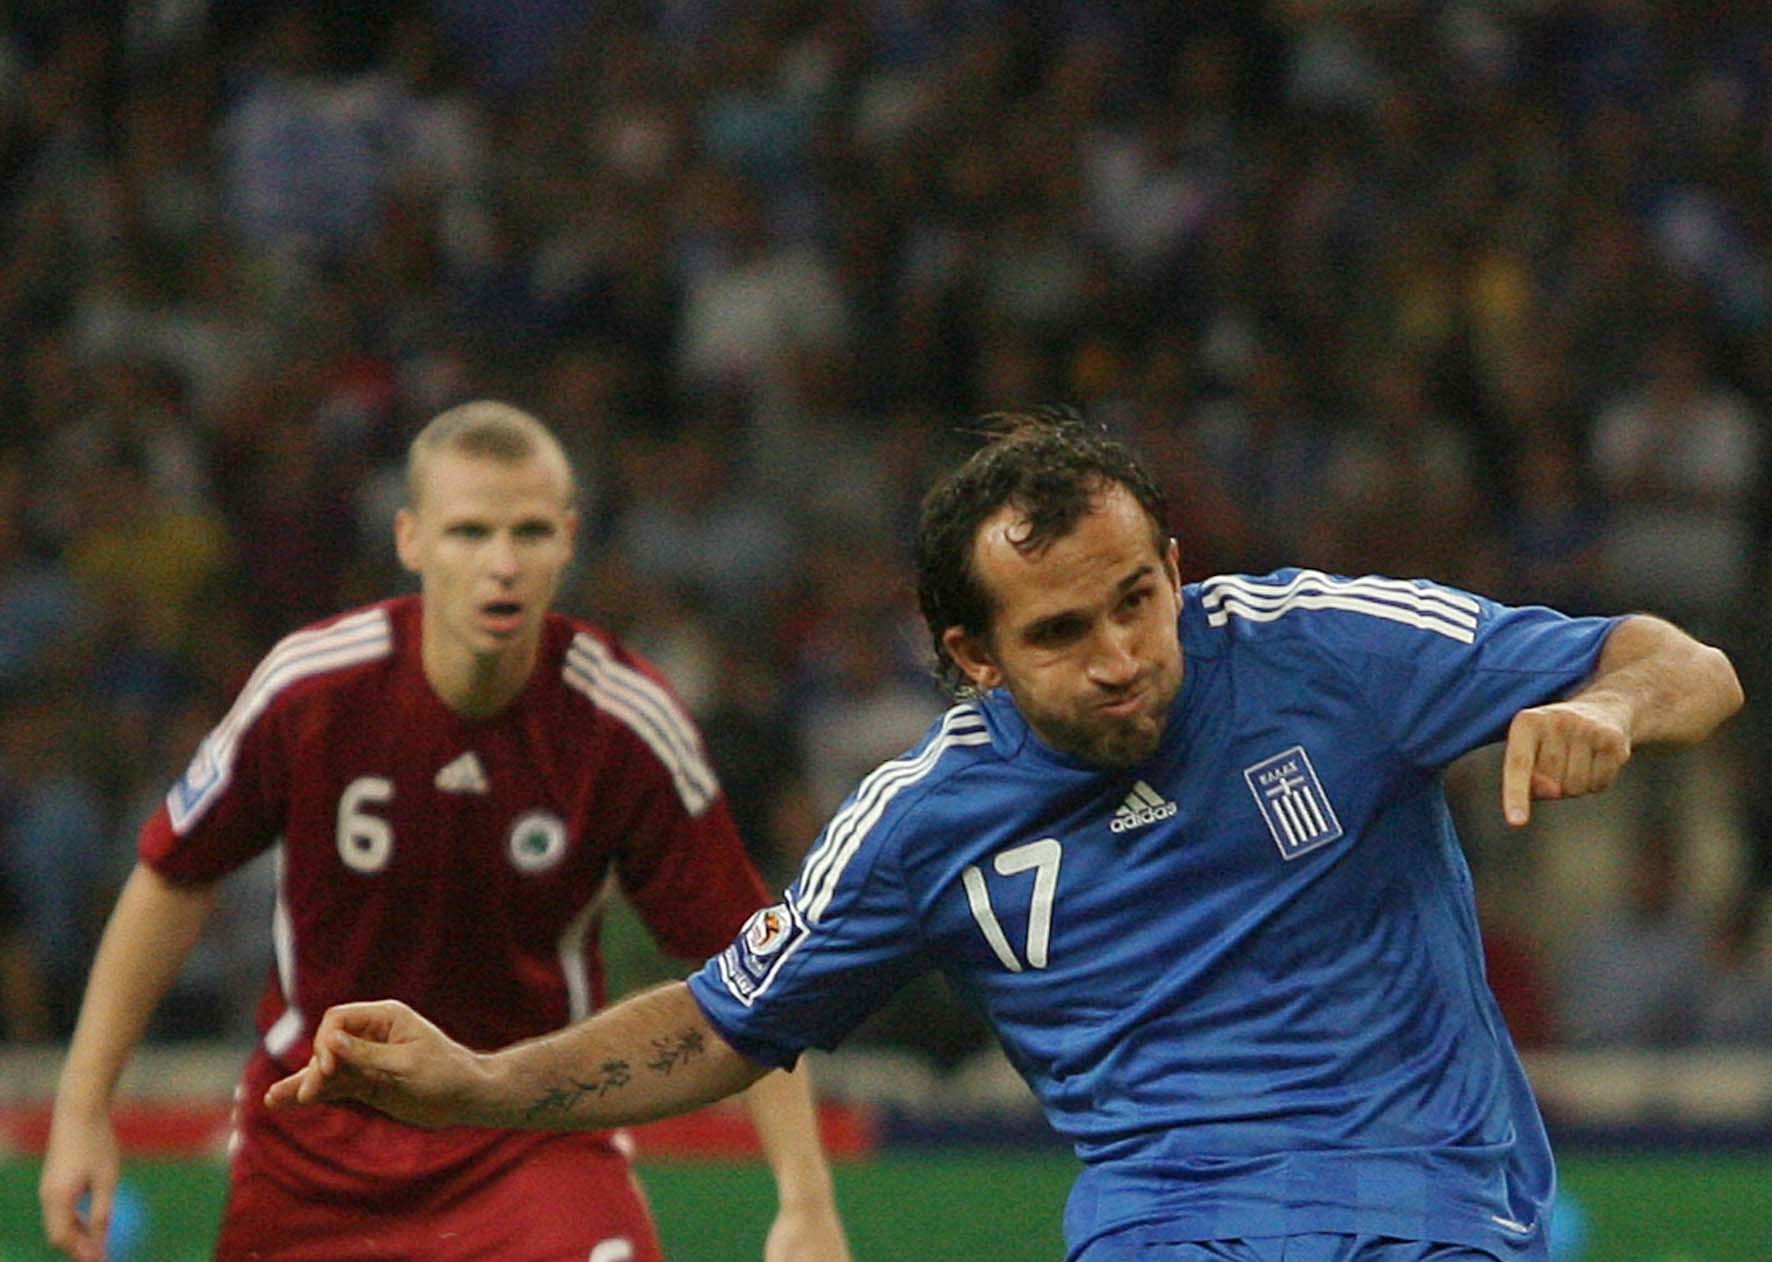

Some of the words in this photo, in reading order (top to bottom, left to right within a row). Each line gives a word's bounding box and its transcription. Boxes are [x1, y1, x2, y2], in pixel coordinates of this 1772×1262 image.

[337, 776, 393, 872] 6
[1110, 801, 1177, 833] adidas
[962, 838, 1061, 973] 17
